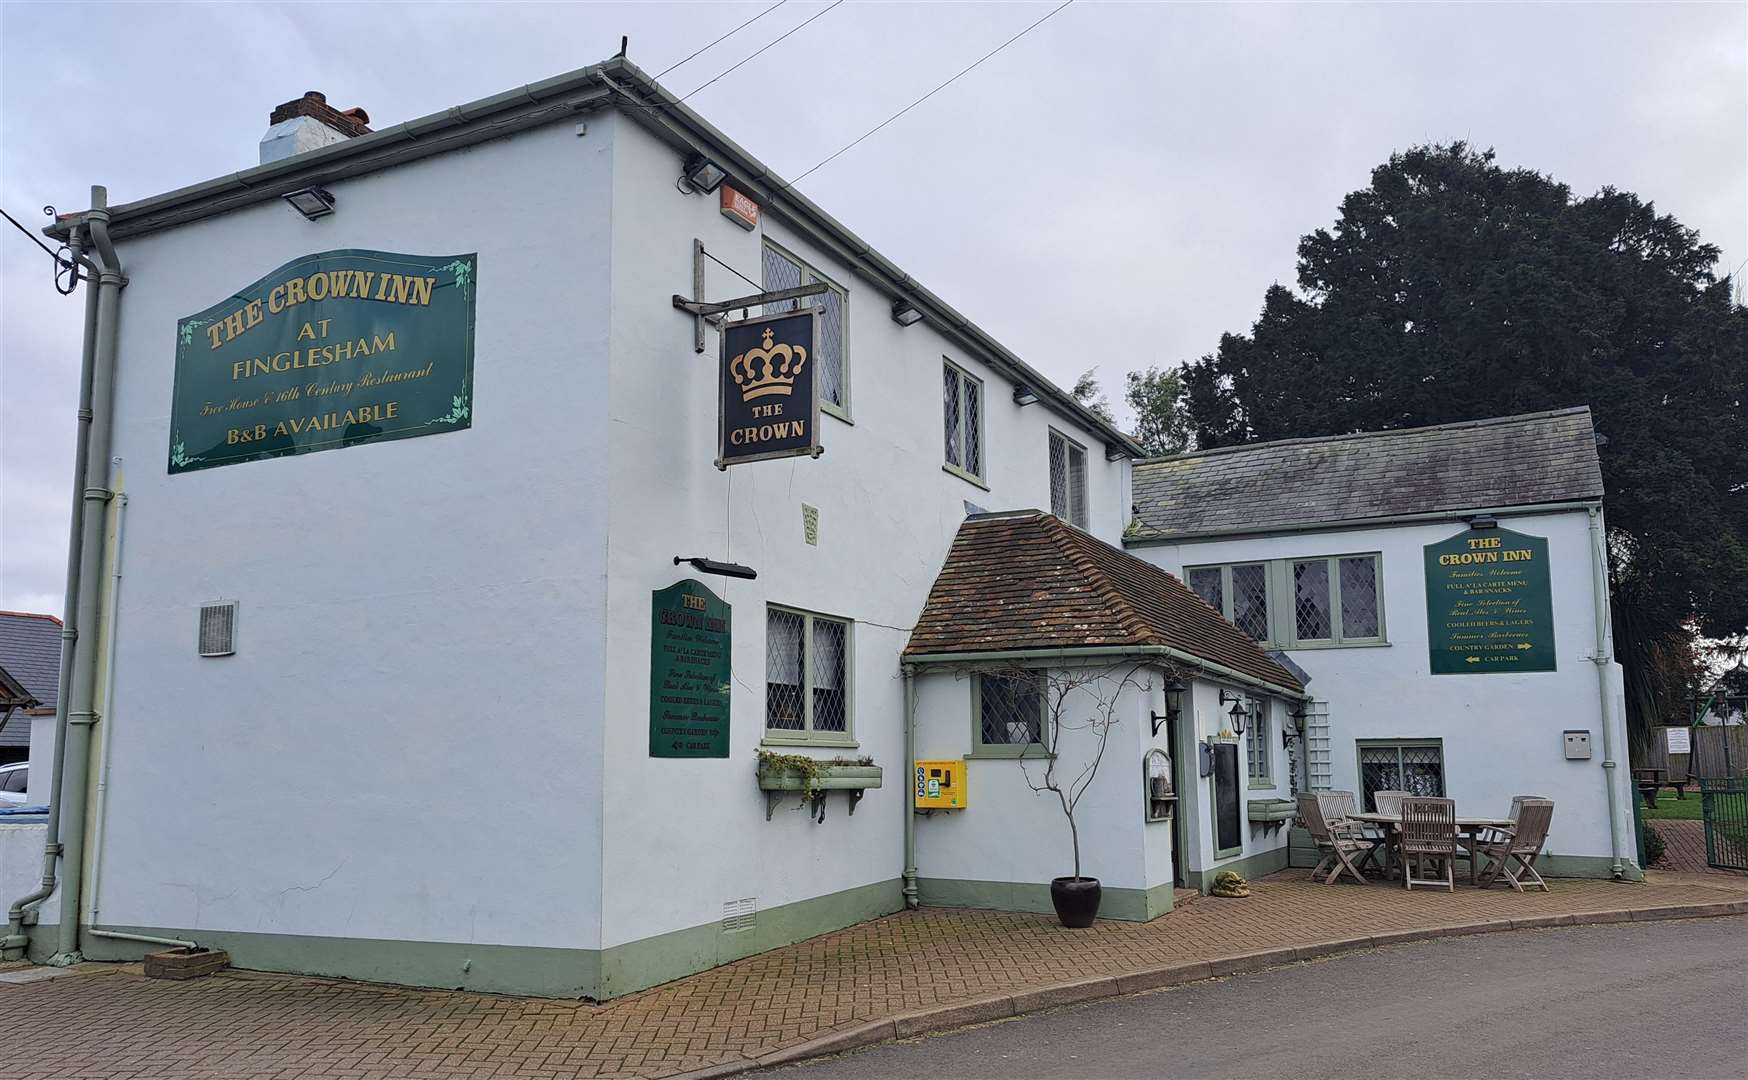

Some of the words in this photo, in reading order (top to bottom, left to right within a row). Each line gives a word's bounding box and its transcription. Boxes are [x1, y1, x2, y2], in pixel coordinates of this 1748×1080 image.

[207, 298, 263, 350] THE
[268, 271, 375, 314] CROWN
[375, 273, 436, 306] INN
[297, 318, 333, 342] AT
[232, 332, 397, 381] FINGLESHAM
[225, 398, 259, 414] House
[276, 386, 299, 403] 16th
[306, 380, 353, 401] Century
[357, 361, 435, 388] Restaurant
[752, 402, 784, 419] THE
[226, 424, 267, 446] B&B
[274, 401, 399, 437] AVAILABLE
[730, 420, 805, 446] CROWN
[1468, 537, 1501, 549] THE
[1439, 551, 1498, 566] CROWN
[1503, 550, 1532, 562] INN
[1449, 570, 1483, 578] Families
[1489, 568, 1522, 577] Welcome
[1507, 579, 1527, 587] MENU
[681, 593, 706, 611] THE
[1504, 607, 1527, 615] Wines
